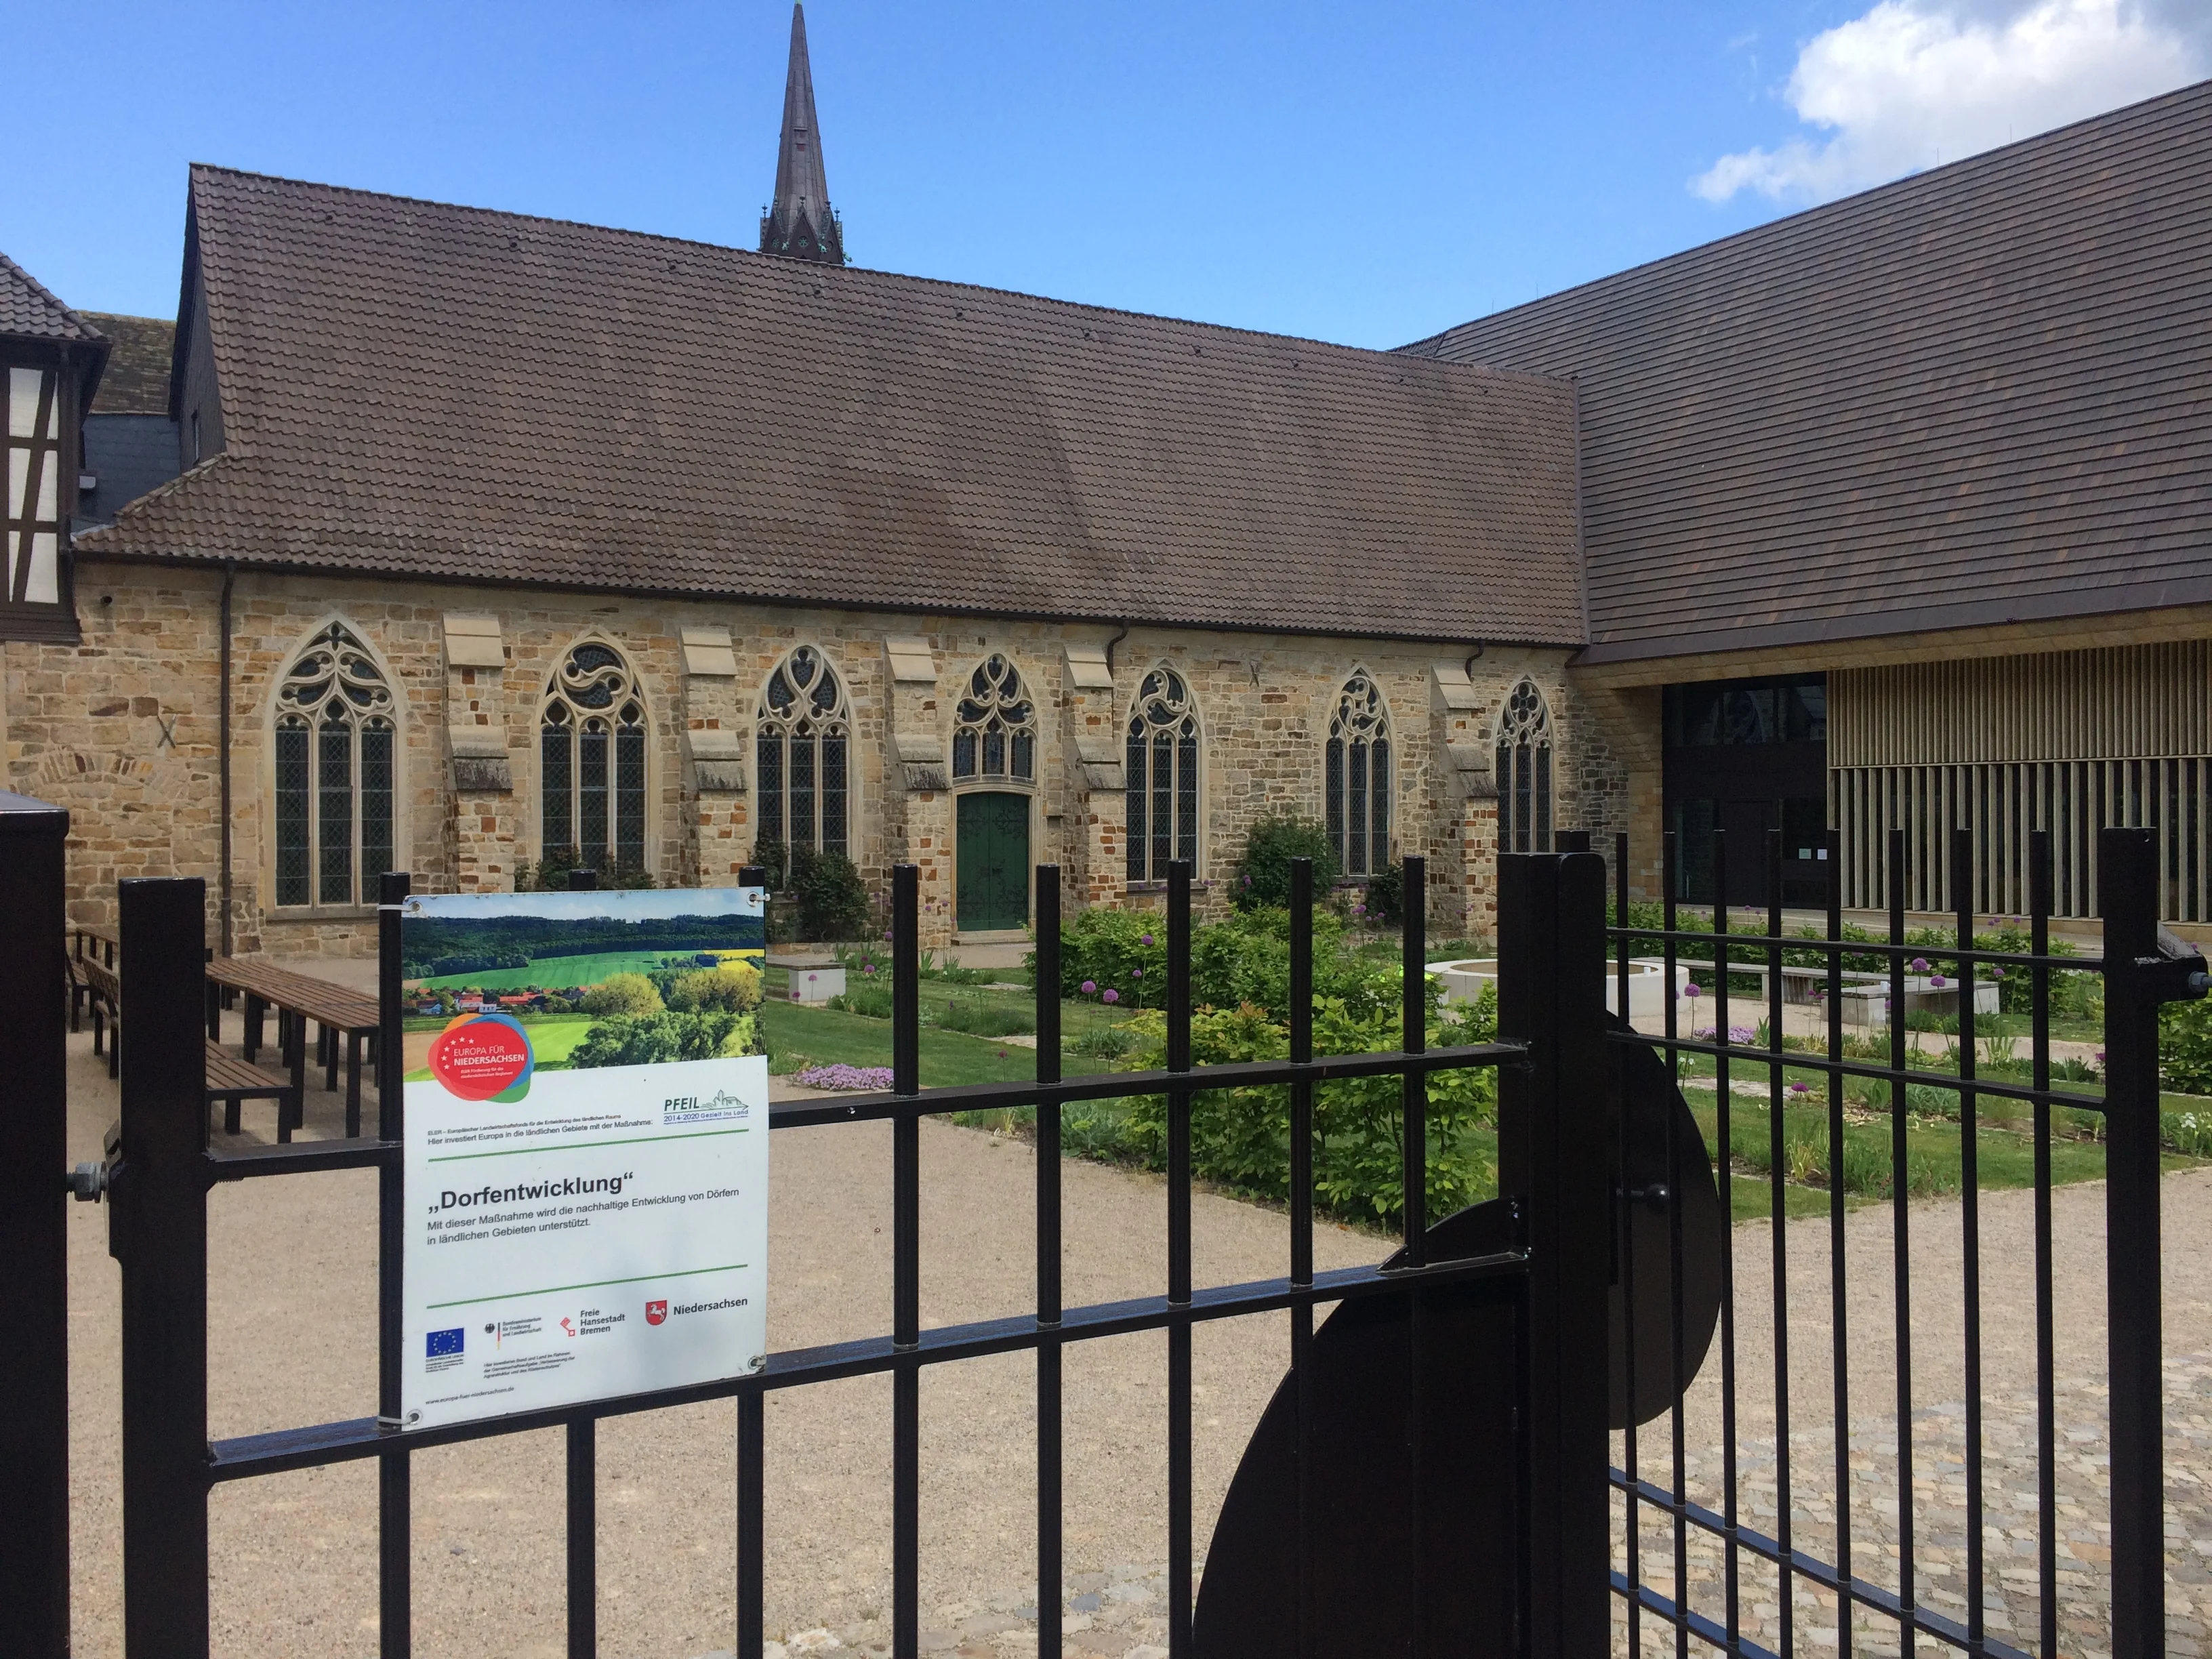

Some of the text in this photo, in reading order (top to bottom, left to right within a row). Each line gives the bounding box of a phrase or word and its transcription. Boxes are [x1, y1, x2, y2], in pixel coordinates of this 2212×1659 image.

[453, 1044, 505, 1057] EUROPA FÜR
[453, 1054, 525, 1066] NIEDERSACHSEN
[663, 1097, 700, 1111] PFEIL
[663, 1113, 700, 1122] 2014-2020
[445, 1134, 477, 1144] investiert
[478, 1132, 504, 1141] Europa
[525, 1126, 560, 1136] ländlichen
[561, 1124, 588, 1133] Gebiete
[614, 1119, 653, 1128] Maßnahme:
[428, 1172, 634, 1214] „Dorfentwicklung“
[427, 1188, 739, 1231] Mit dieser Maßnahme wird die nachhaltige Entwicklung von Dörfern
[427, 1218, 590, 1246] in ländlichen Gebieten unterstützt.
[673, 1298, 748, 1315] Niedersachsen
[580, 1309, 600, 1318] Freie
[580, 1313, 626, 1326] Hansestadt
[580, 1325, 611, 1336] Bremen
